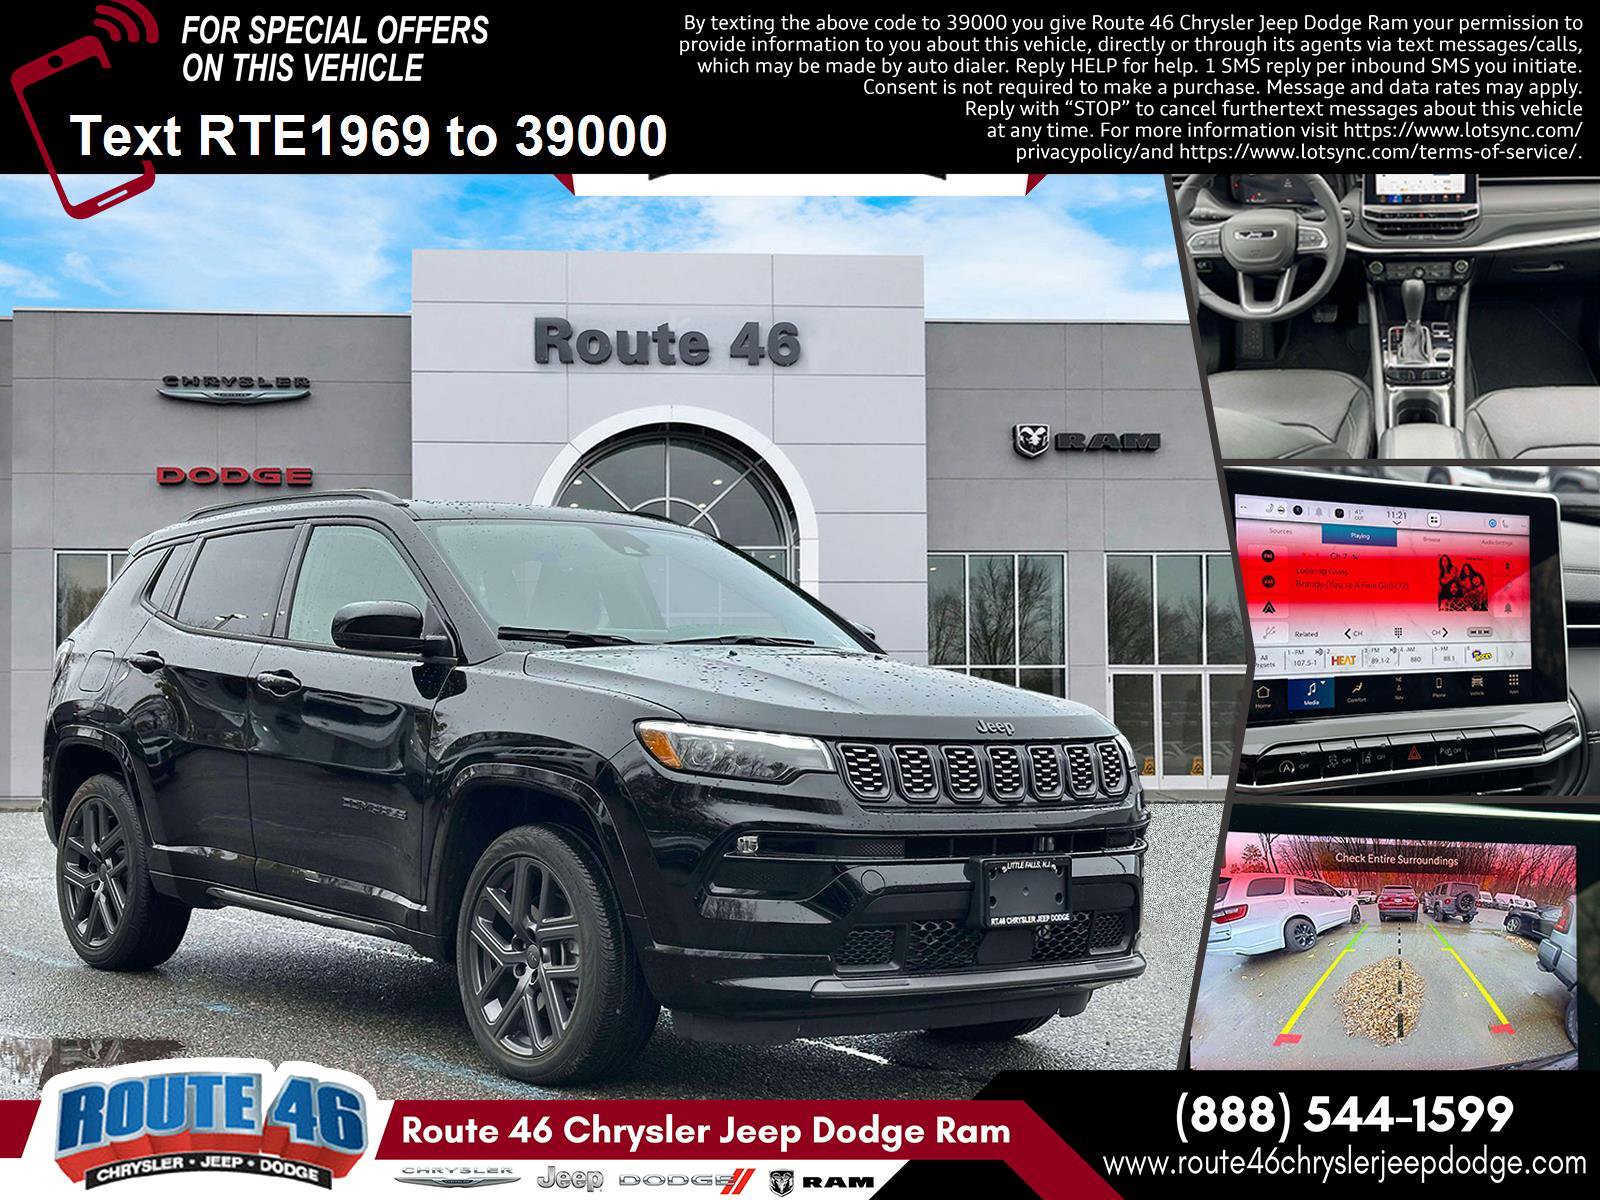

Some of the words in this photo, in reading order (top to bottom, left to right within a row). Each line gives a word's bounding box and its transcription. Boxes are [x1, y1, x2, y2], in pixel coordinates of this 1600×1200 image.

[534, 317, 710, 366] Route
[730, 321, 801, 367] 46
[162, 375, 310, 388] CHRYSLER
[1054, 432, 1161, 452] RAM
[157, 466, 313, 486] DODGE
[1386, 511, 1407, 519] 11:21
[1351, 532, 1371, 541] Playing
[1331, 655, 1356, 666] HEAT
[976, 720, 1016, 736] Jeep
[1335, 852, 1366, 863] Check
[1368, 854, 1396, 864] Entire
[1398, 855, 1459, 867] Surroundings
[1006, 915, 1036, 924] CHRYSLER
[1036, 914, 1050, 922] JEEP
[1050, 913, 1070, 921] DODGE
